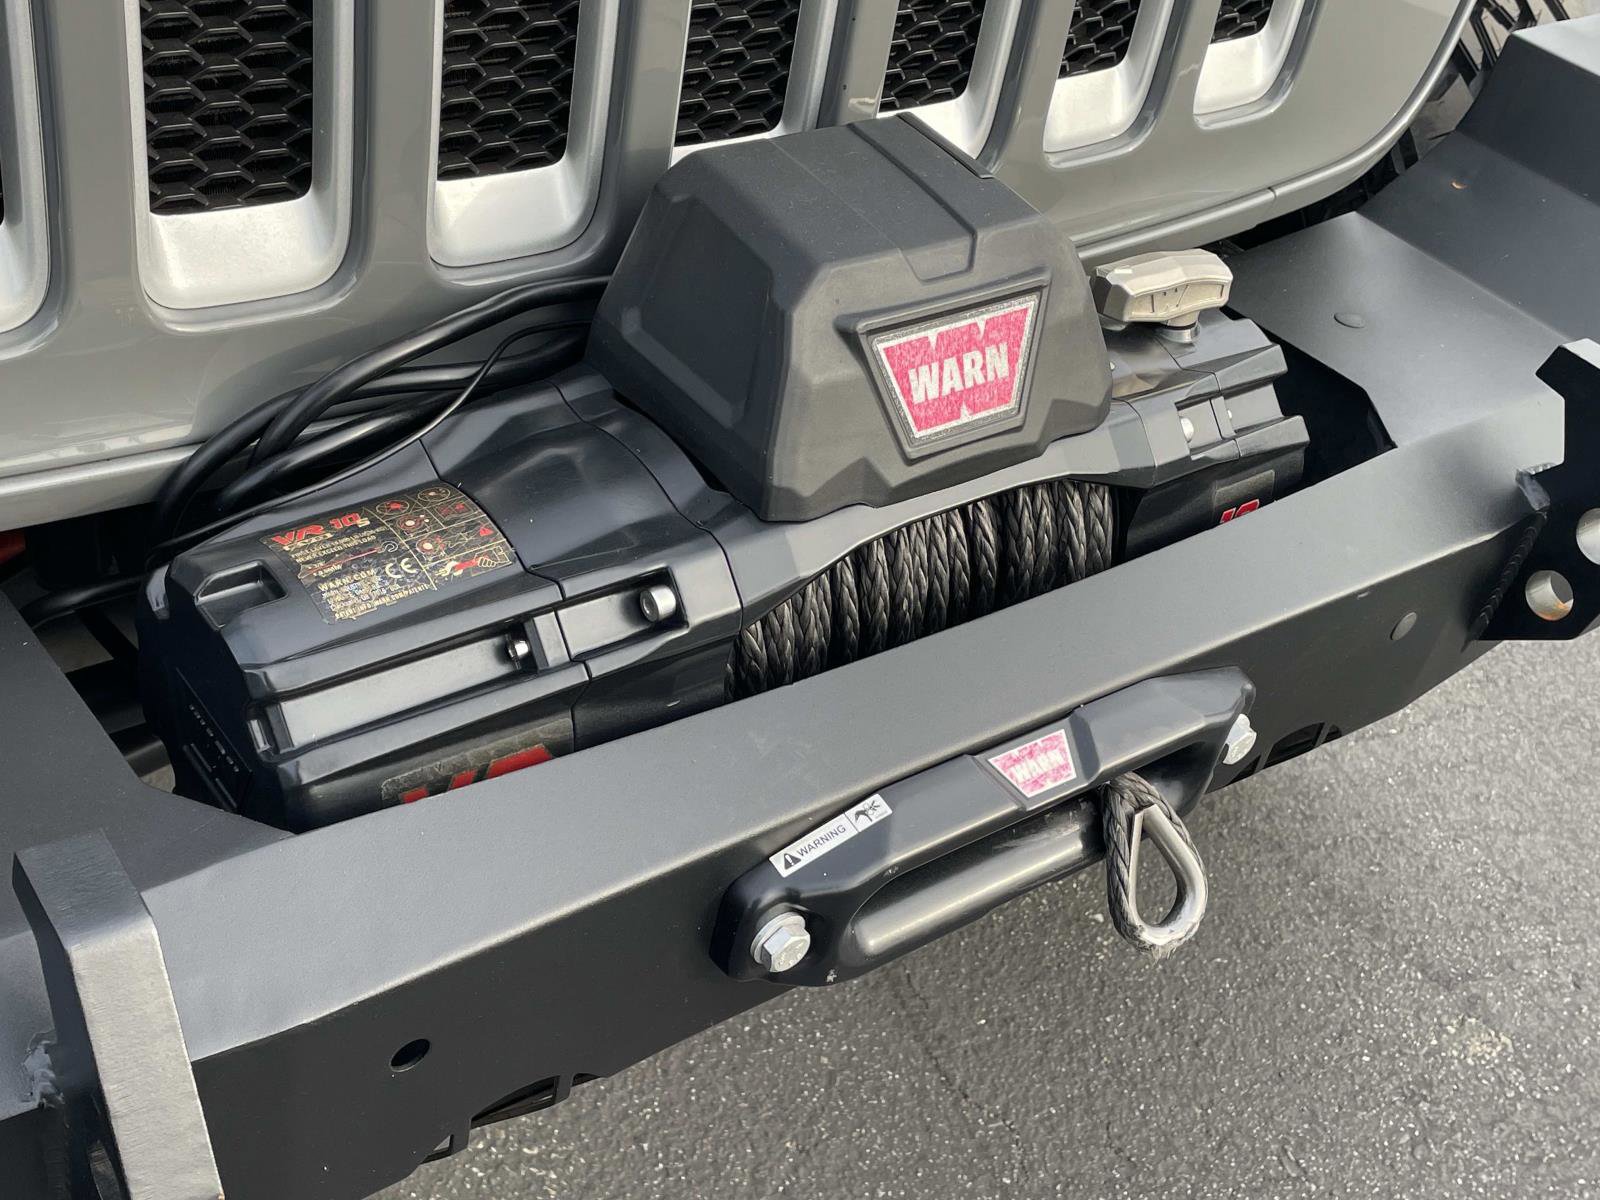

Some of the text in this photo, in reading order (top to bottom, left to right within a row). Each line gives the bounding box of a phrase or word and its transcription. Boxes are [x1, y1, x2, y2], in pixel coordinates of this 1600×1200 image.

[907, 341, 1010, 405] WARN
[271, 524, 325, 545] VR
[358, 534, 376, 543] LOAD
[796, 823, 847, 858] WARNING
